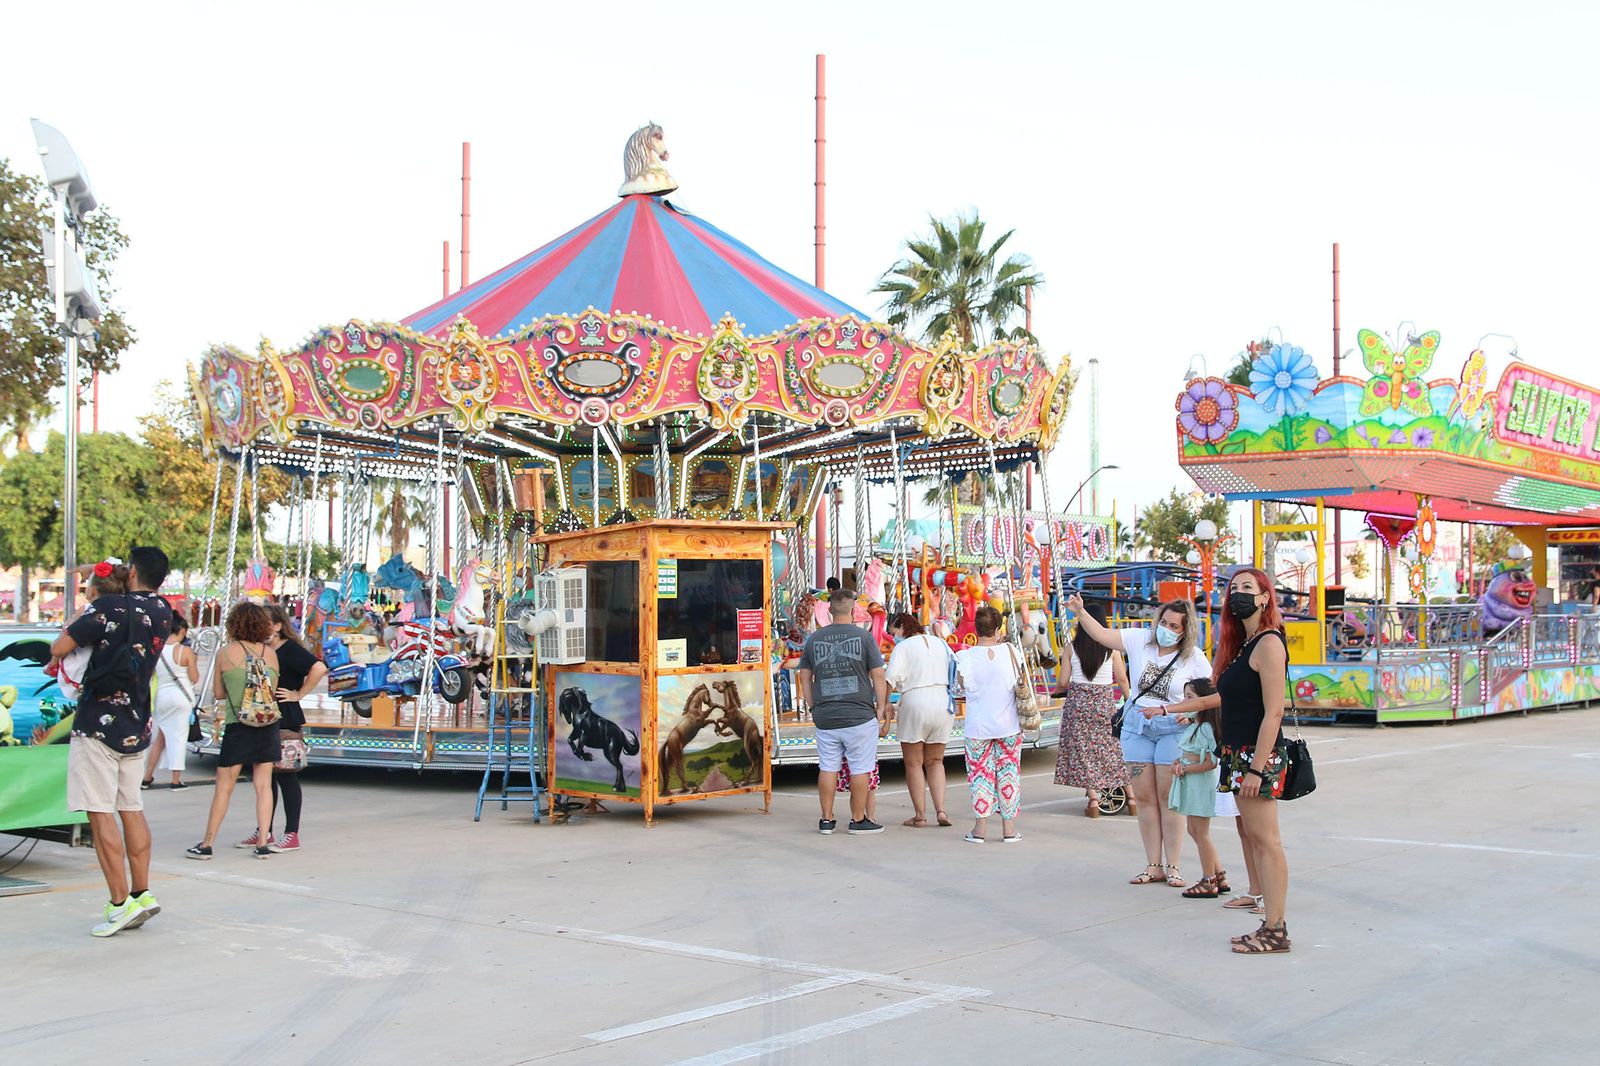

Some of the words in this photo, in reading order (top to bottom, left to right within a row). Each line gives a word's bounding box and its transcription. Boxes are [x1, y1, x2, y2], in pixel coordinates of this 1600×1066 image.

[1505, 379, 1591, 447] SUPER
[968, 513, 1107, 560] GUNO
[815, 642, 832, 661] FOX
